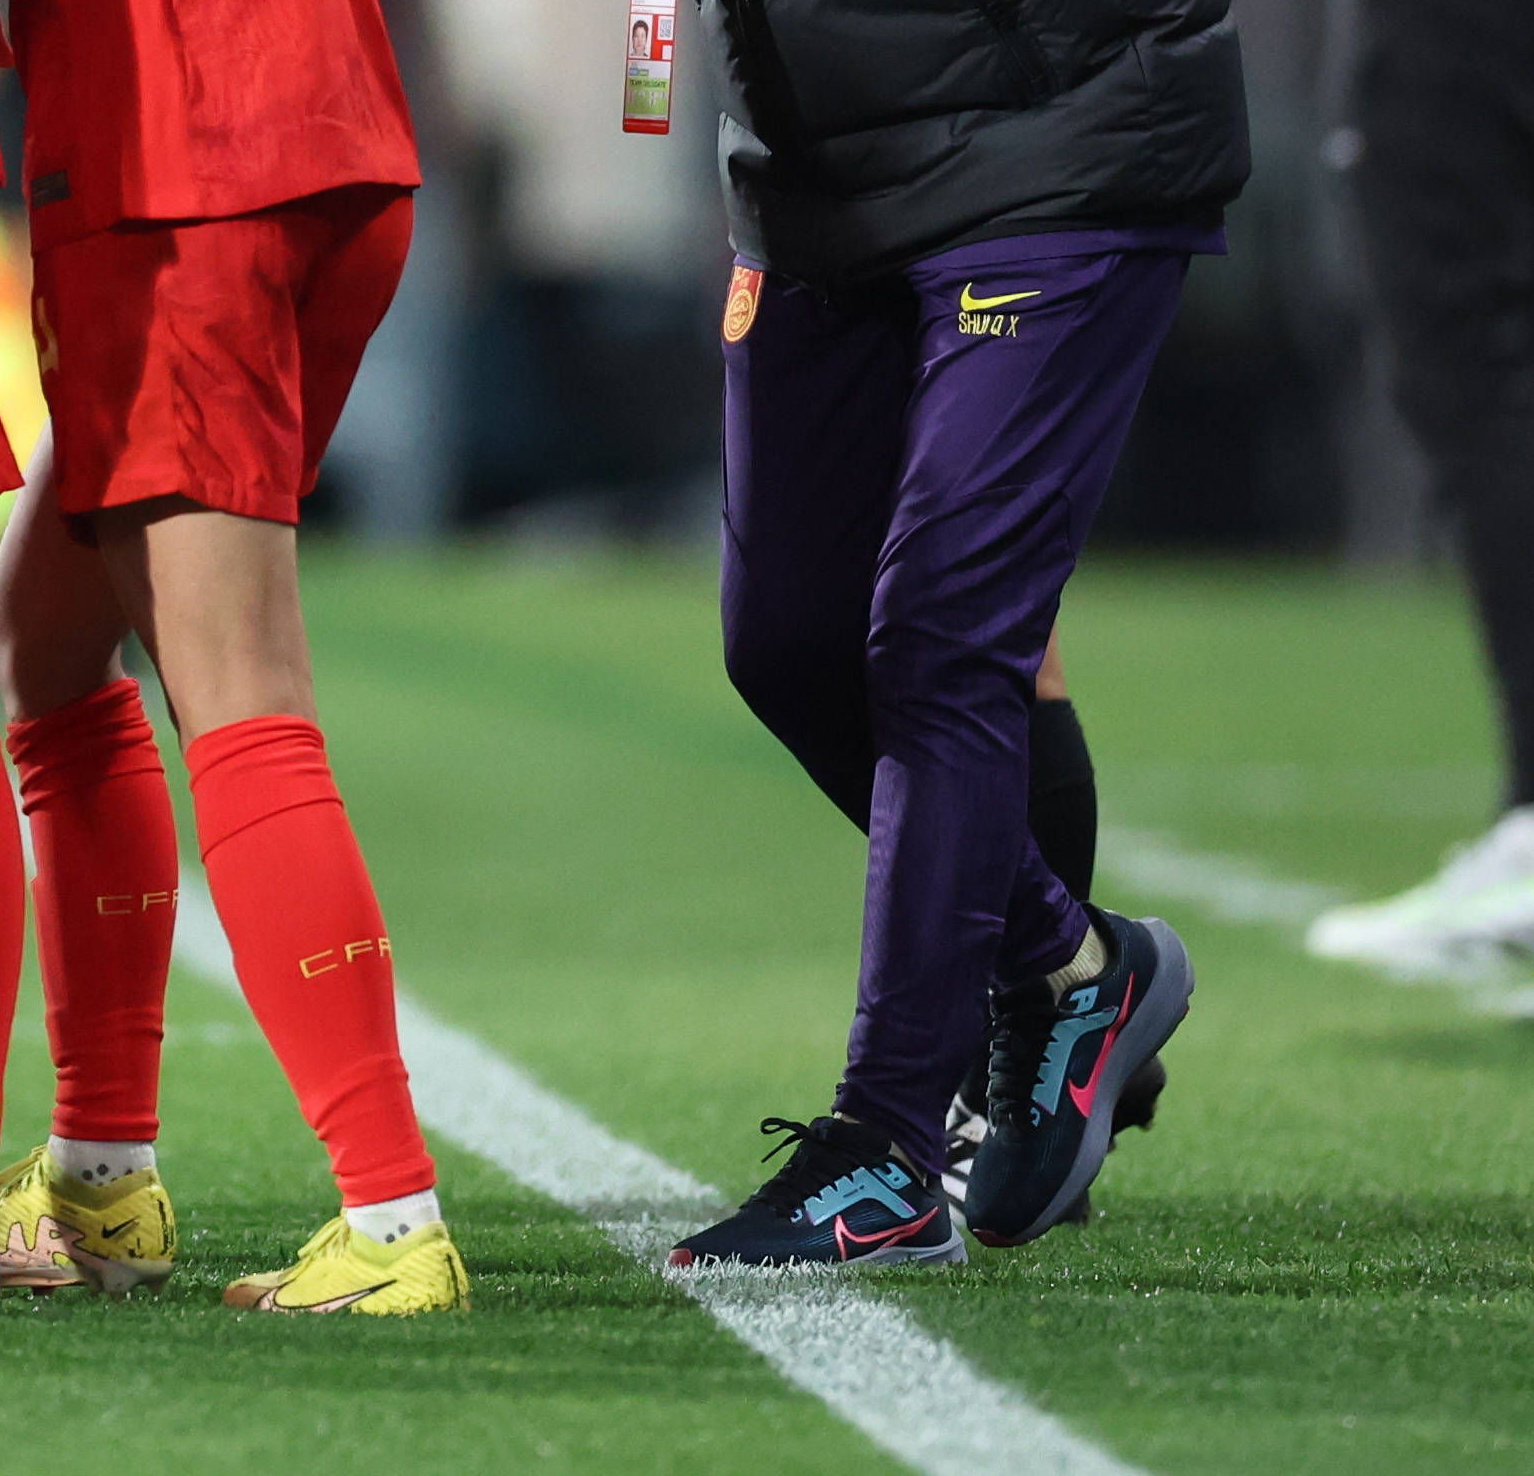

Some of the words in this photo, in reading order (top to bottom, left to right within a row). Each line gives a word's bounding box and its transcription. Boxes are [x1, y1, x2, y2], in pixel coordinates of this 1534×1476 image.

[958, 312, 989, 336] SHUI
[990, 314, 1002, 336] Q
[1006, 315, 1020, 337] X
